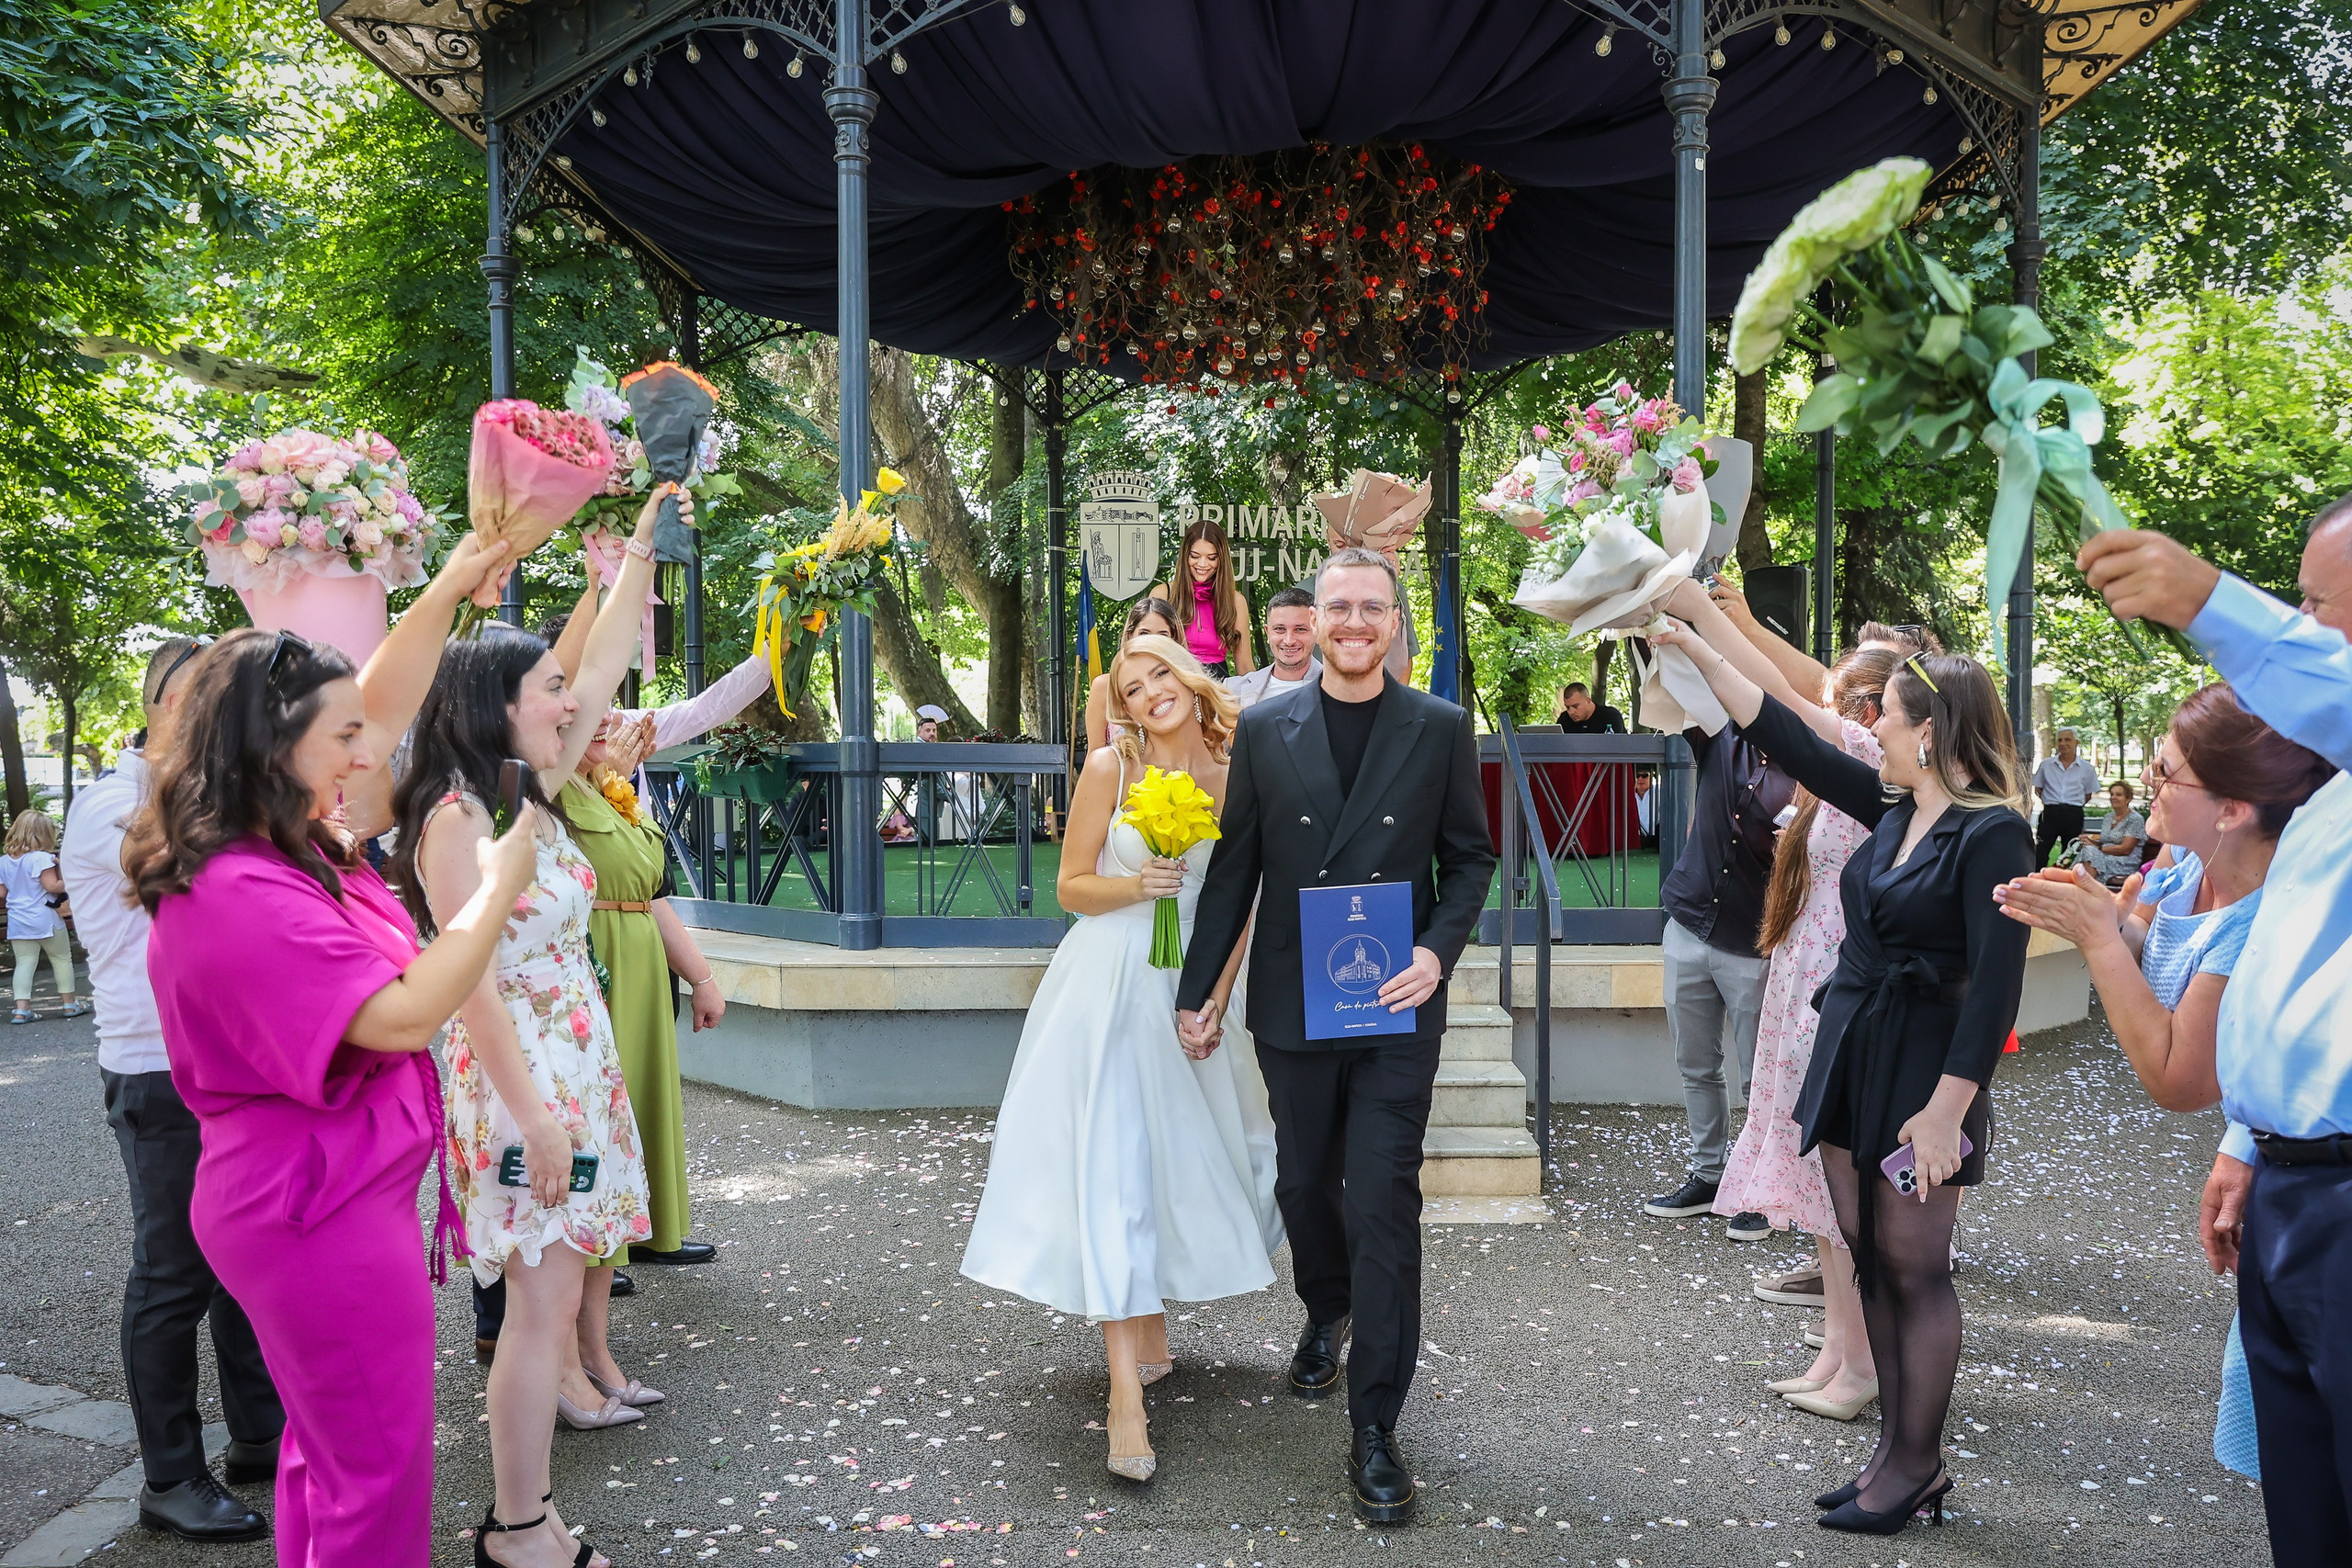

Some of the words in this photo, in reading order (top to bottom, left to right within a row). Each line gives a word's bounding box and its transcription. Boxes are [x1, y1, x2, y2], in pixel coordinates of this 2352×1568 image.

[1179, 504, 1329, 539] PRIMARI
[1335, 1001, 1353, 1012] Casa
[1354, 1000, 1363, 1010] de
[1362, 998, 1380, 1011] piatr
